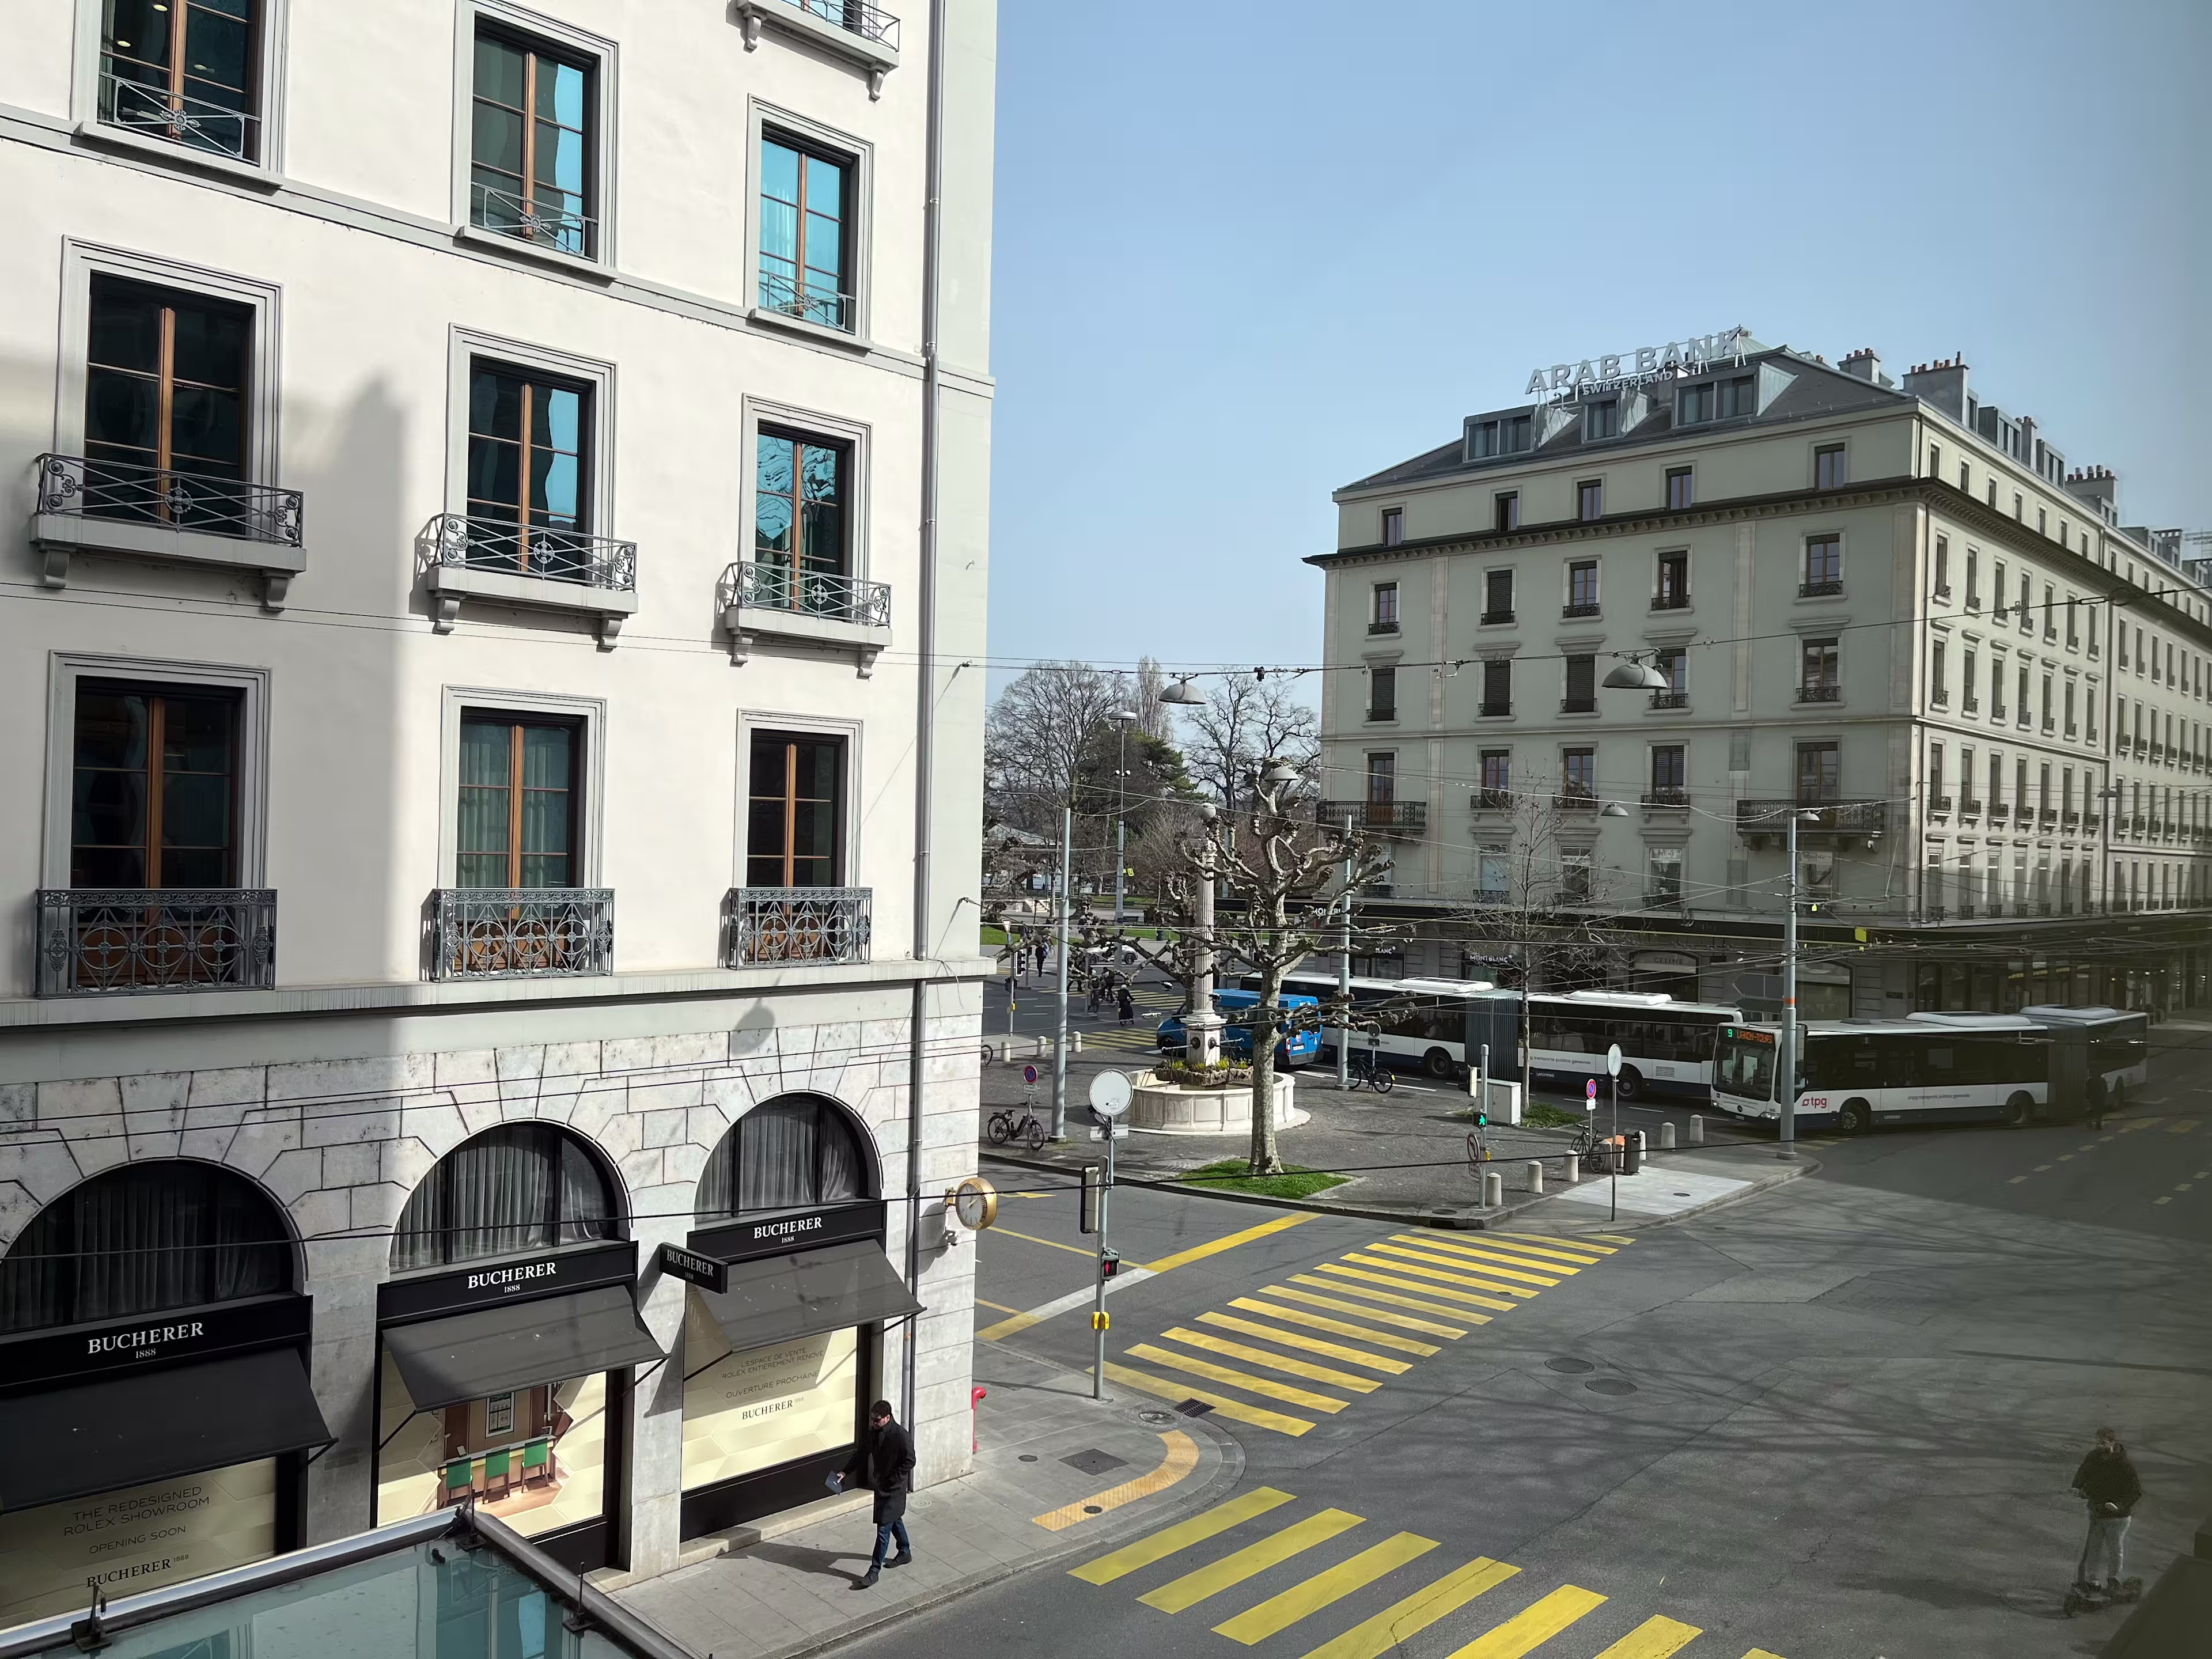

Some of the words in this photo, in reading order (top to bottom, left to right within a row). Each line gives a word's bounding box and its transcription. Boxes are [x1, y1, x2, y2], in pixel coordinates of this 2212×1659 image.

[1525, 354, 1620, 395] ARAB
[1636, 327, 1741, 373] BANK
[1583, 370, 1673, 396] SWITZERLAND
[1653, 957, 1683, 965] CELINE
[1728, 1029, 1733, 1037] 9
[753, 1217, 823, 1239] BUCHERER
[781, 1236, 794, 1244] 1888
[467, 1262, 556, 1289] BUCHERER
[666, 1249, 714, 1277] BUCHERER
[504, 1283, 520, 1293] 1888
[88, 1322, 204, 1354] BUCHERER
[135, 1348, 157, 1359] 1888
[741, 1355, 772, 1368] L'ESPACE
[785, 1347, 807, 1358] VENTE
[722, 1369, 747, 1379] ROLEX
[726, 1381, 774, 1399] OUVERTURE
[776, 1370, 820, 1387] PROCHAINE
[741, 1400, 793, 1421] BUCHERER
[64, 1517, 115, 1536] ROLEX
[120, 1497, 209, 1524] SHOWROOM
[73, 1507, 103, 1521] THE
[108, 1486, 202, 1514] REDESIGNED
[89, 1534, 146, 1554] OPENING
[150, 1525, 186, 1540] SOON
[86, 1558, 172, 1588] BUCHERER
[173, 1554, 190, 1563] 1888
